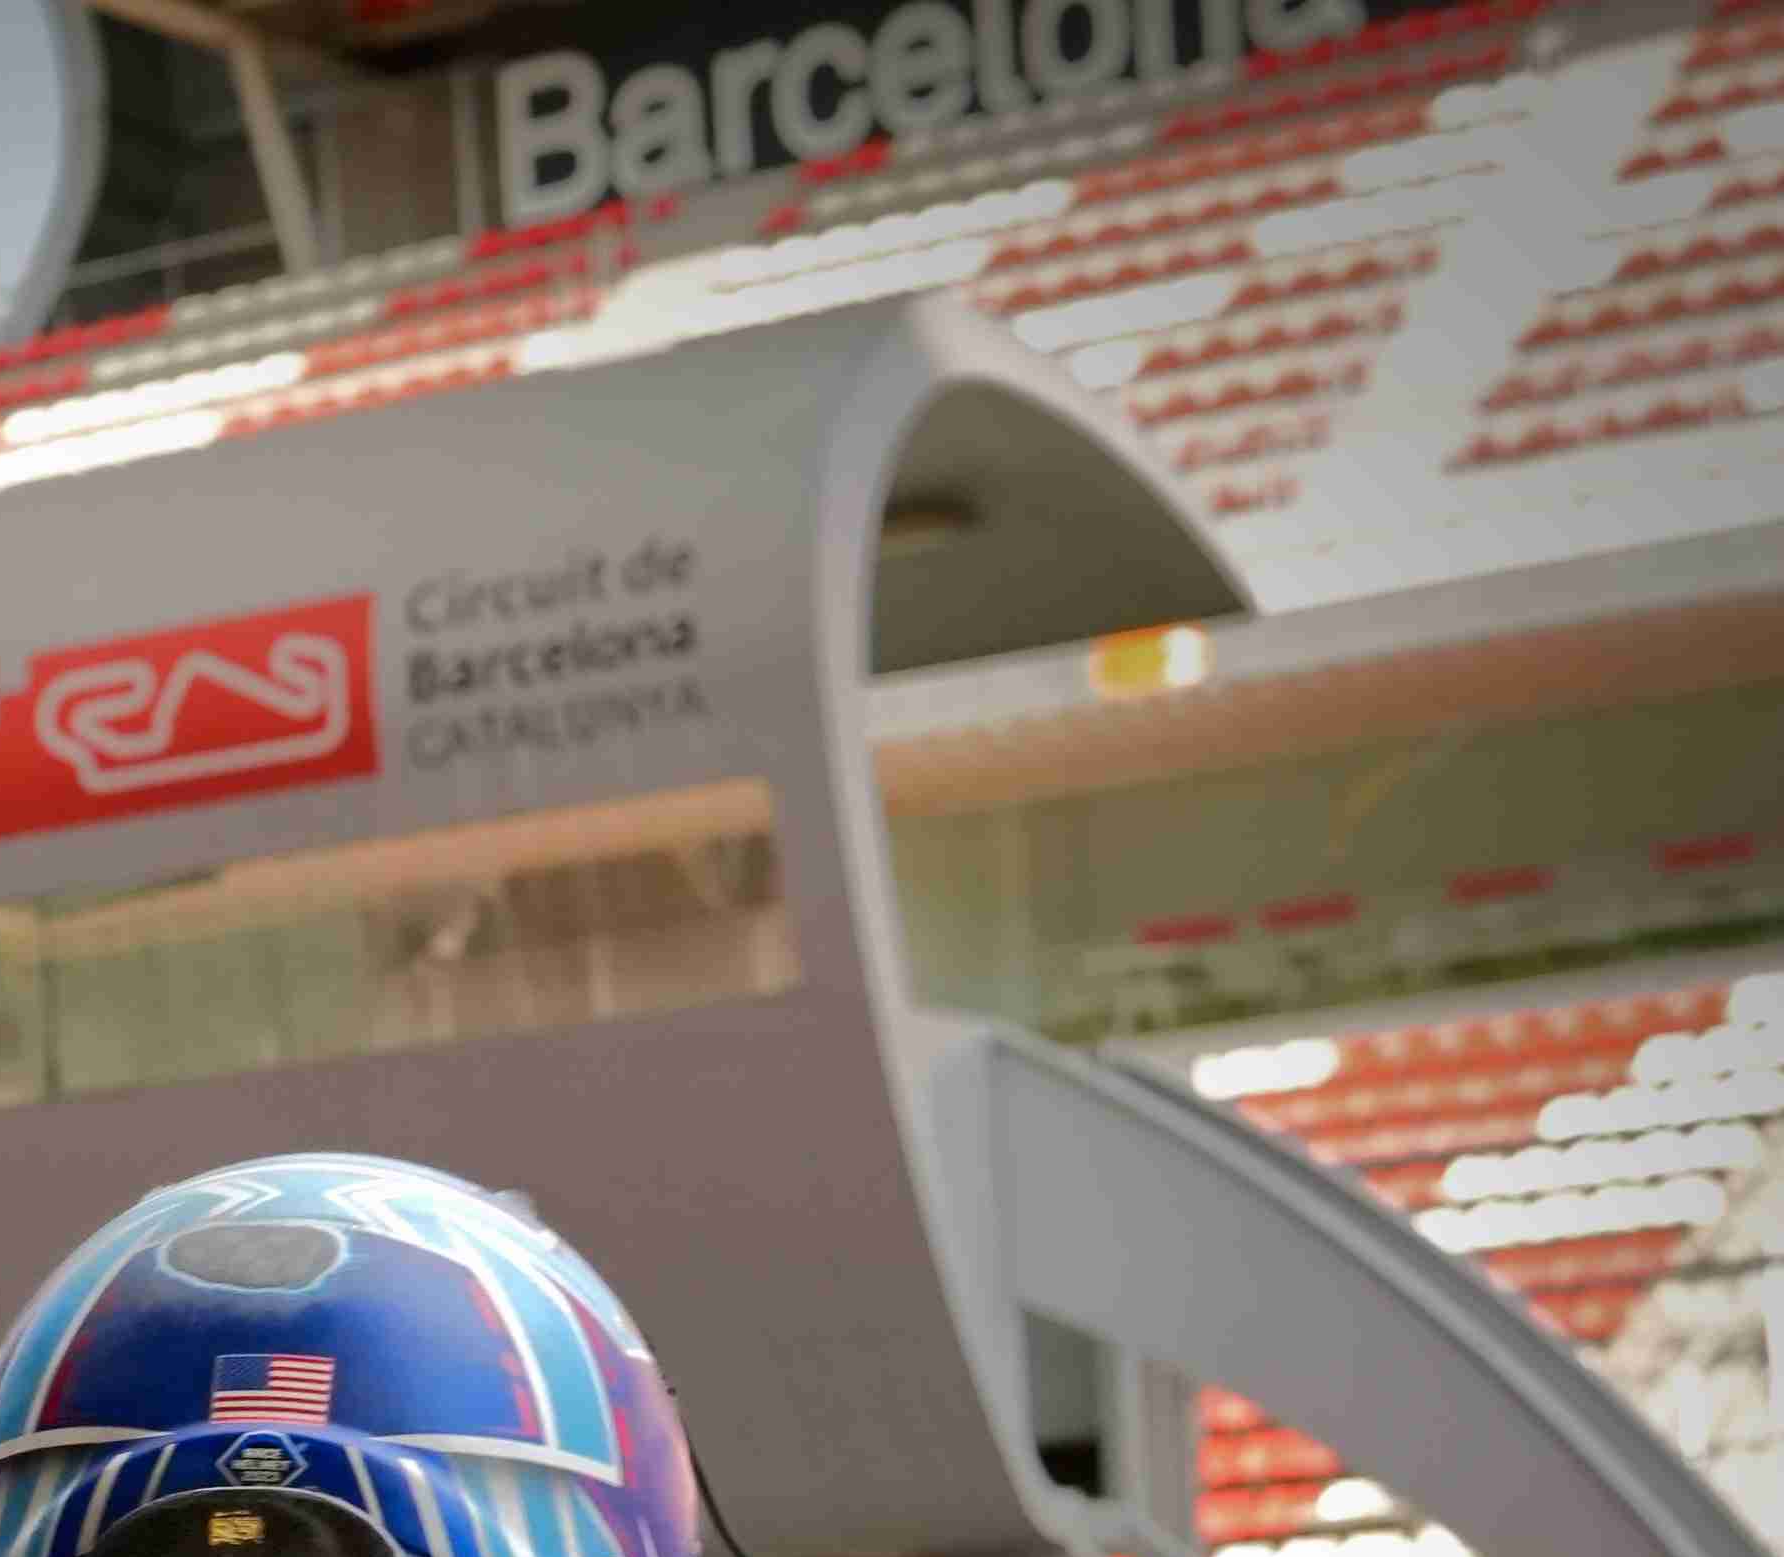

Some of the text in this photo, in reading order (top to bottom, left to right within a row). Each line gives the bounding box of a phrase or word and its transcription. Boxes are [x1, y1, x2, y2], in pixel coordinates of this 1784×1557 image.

[406, 532, 697, 638] Circuit de
[406, 615, 697, 702] Barcelona
